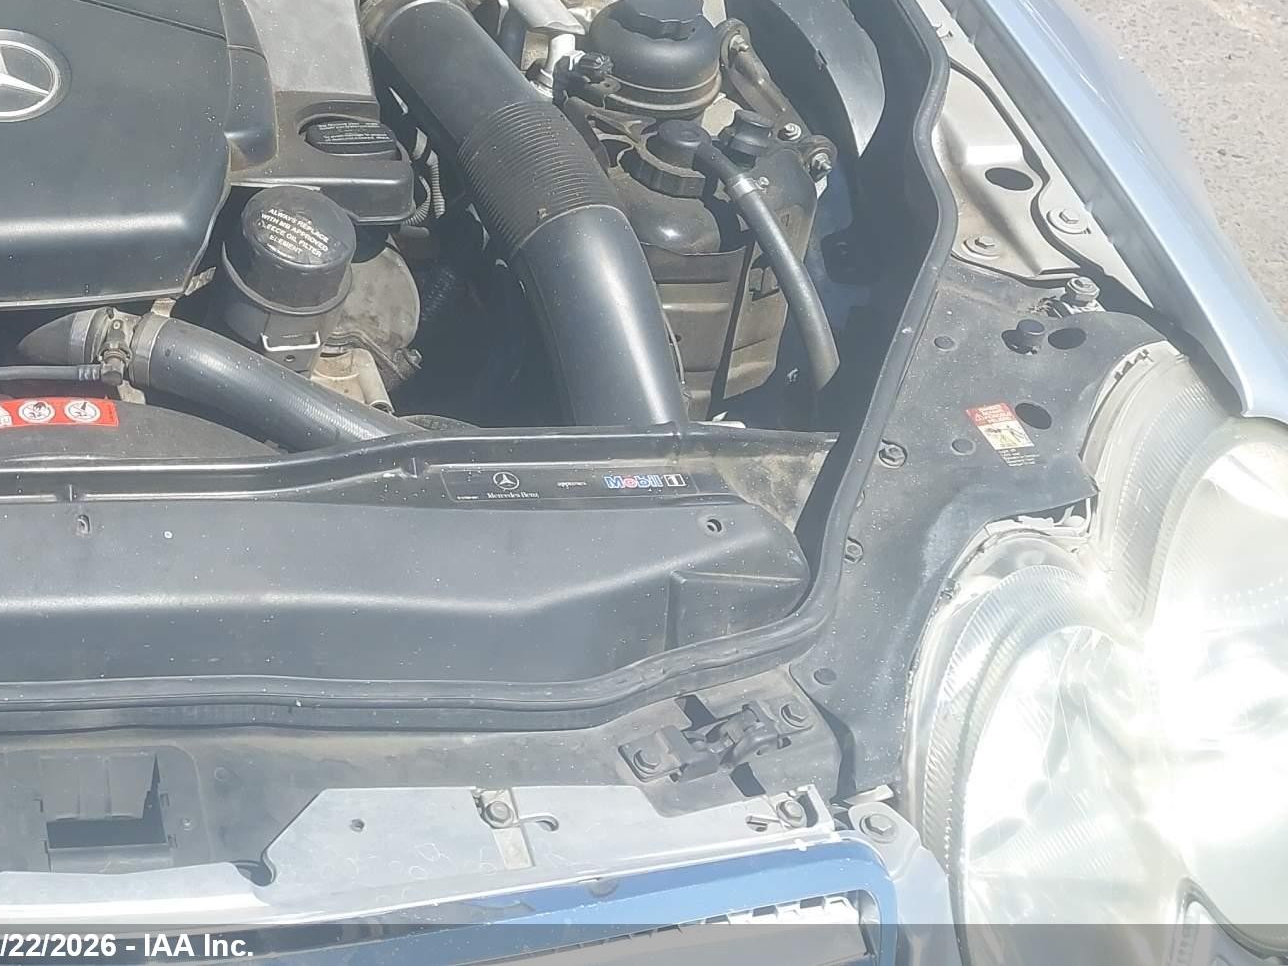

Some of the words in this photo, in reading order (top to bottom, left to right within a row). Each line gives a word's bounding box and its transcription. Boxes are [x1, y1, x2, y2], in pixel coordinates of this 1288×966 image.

[261, 213, 280, 225] WITH
[268, 208, 297, 224] ALWAYS
[603, 474, 664, 489] Mobil
